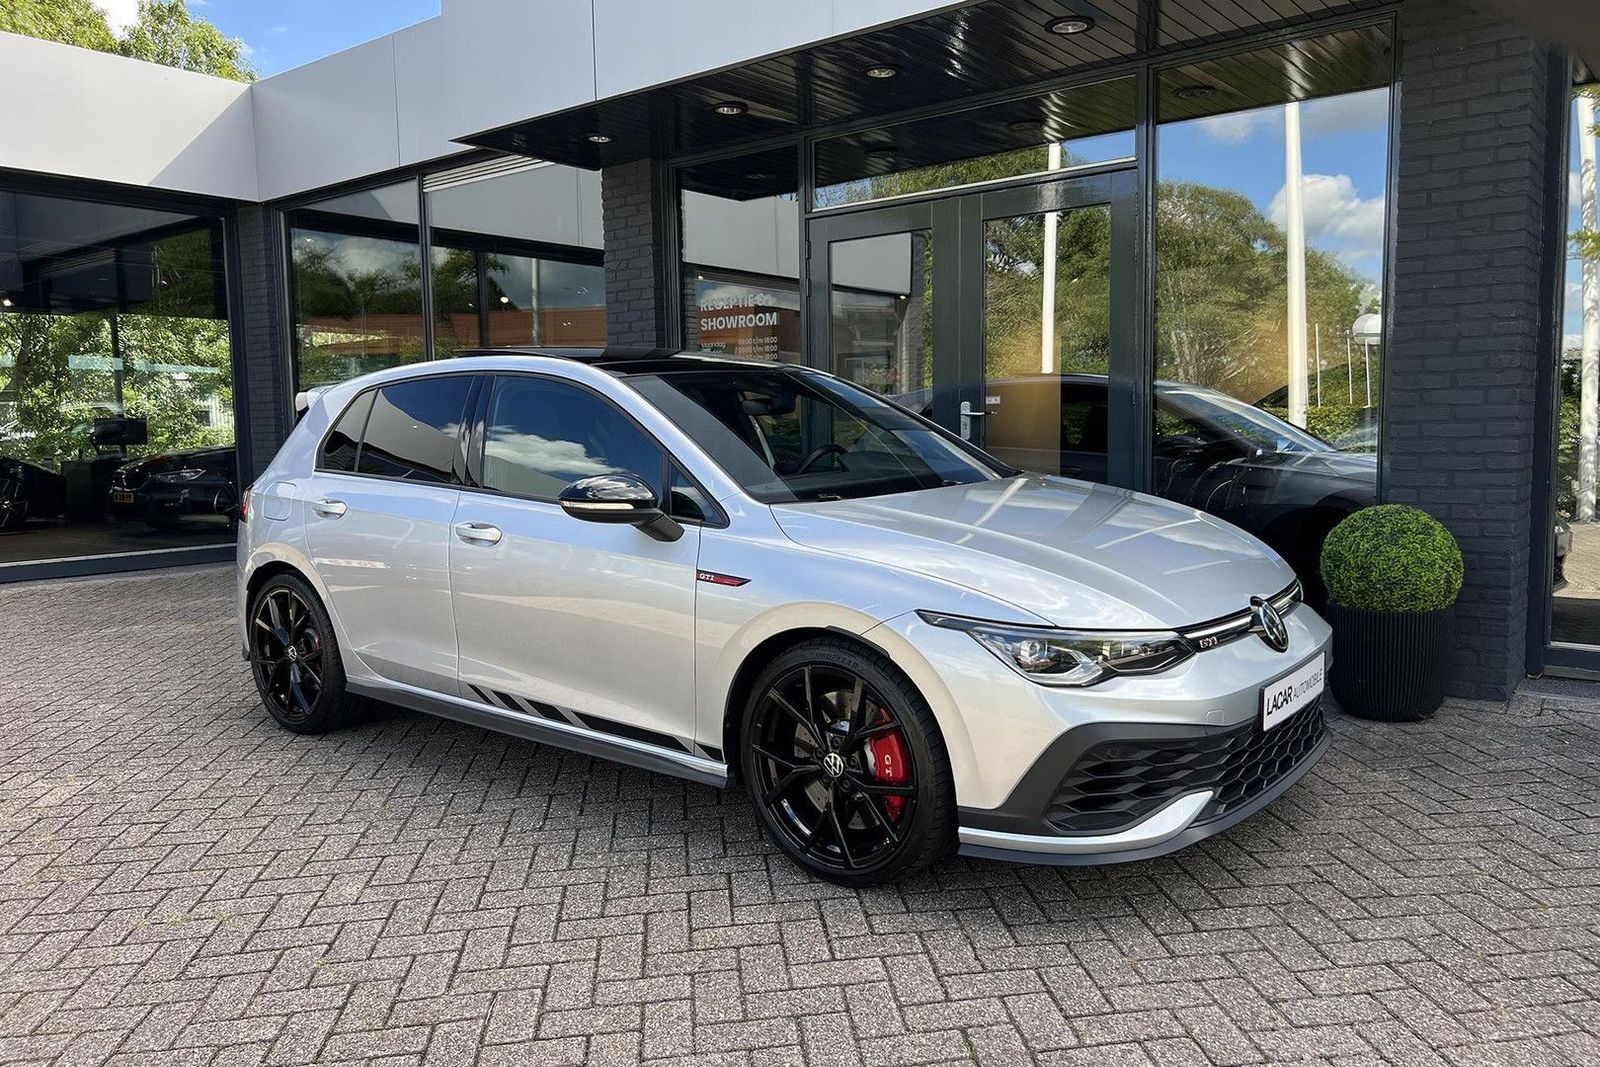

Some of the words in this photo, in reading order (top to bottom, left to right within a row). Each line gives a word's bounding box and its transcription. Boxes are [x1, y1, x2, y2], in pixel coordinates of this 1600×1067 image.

[700, 294, 755, 312] RECEPTIE
[700, 312, 778, 331] SHOWROOM
[701, 341, 726, 349] Maandag
[699, 572, 715, 581] GTI
[1267, 685, 1293, 717] LACAR
[884, 754, 893, 781] GT
